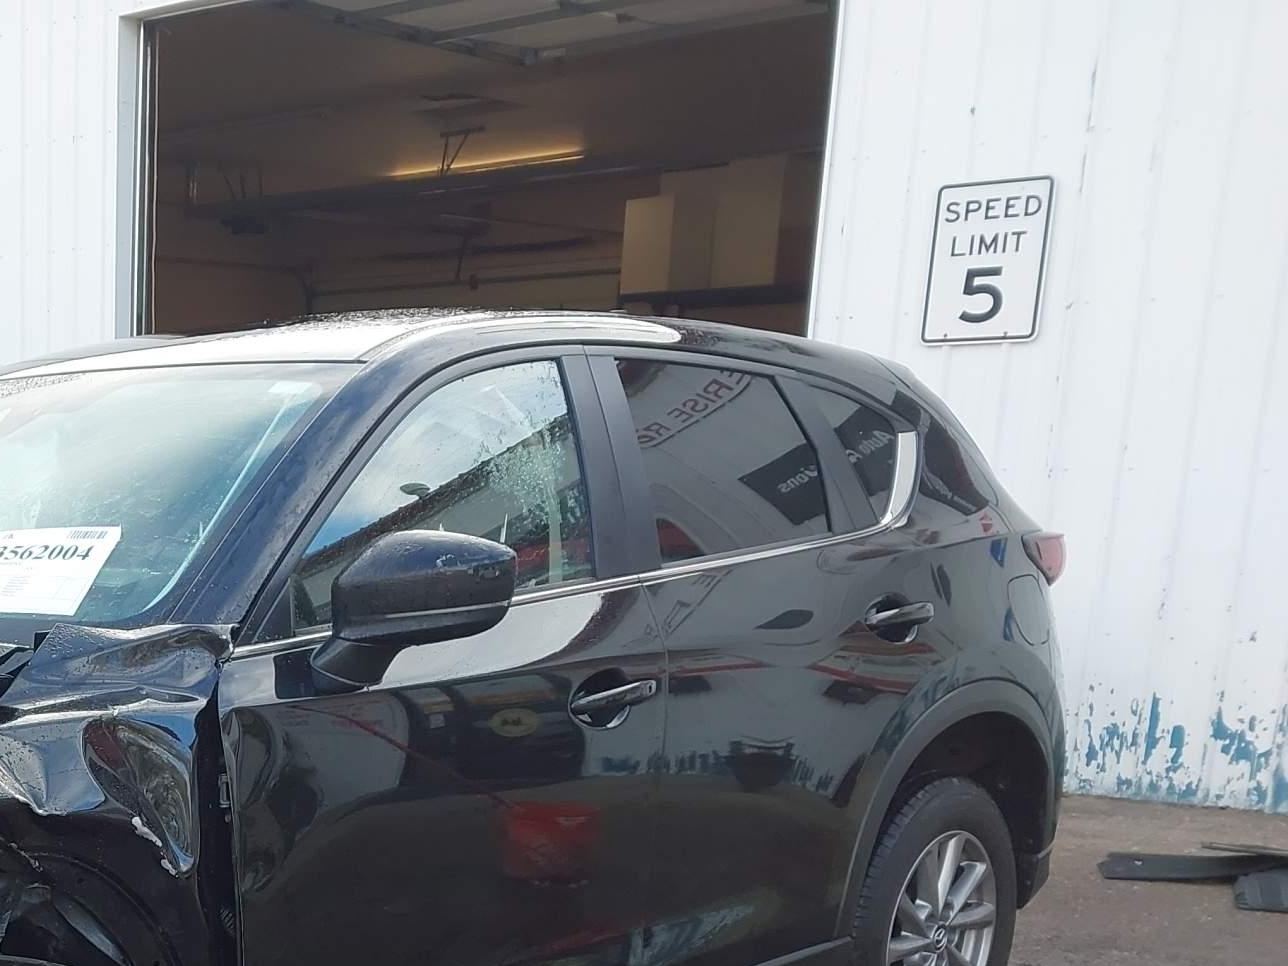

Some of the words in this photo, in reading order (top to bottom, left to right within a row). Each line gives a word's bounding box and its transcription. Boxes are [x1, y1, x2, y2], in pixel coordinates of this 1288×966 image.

[944, 194, 1042, 223] SPEED
[950, 230, 1028, 257] LIMIT
[958, 266, 1004, 324] 5
